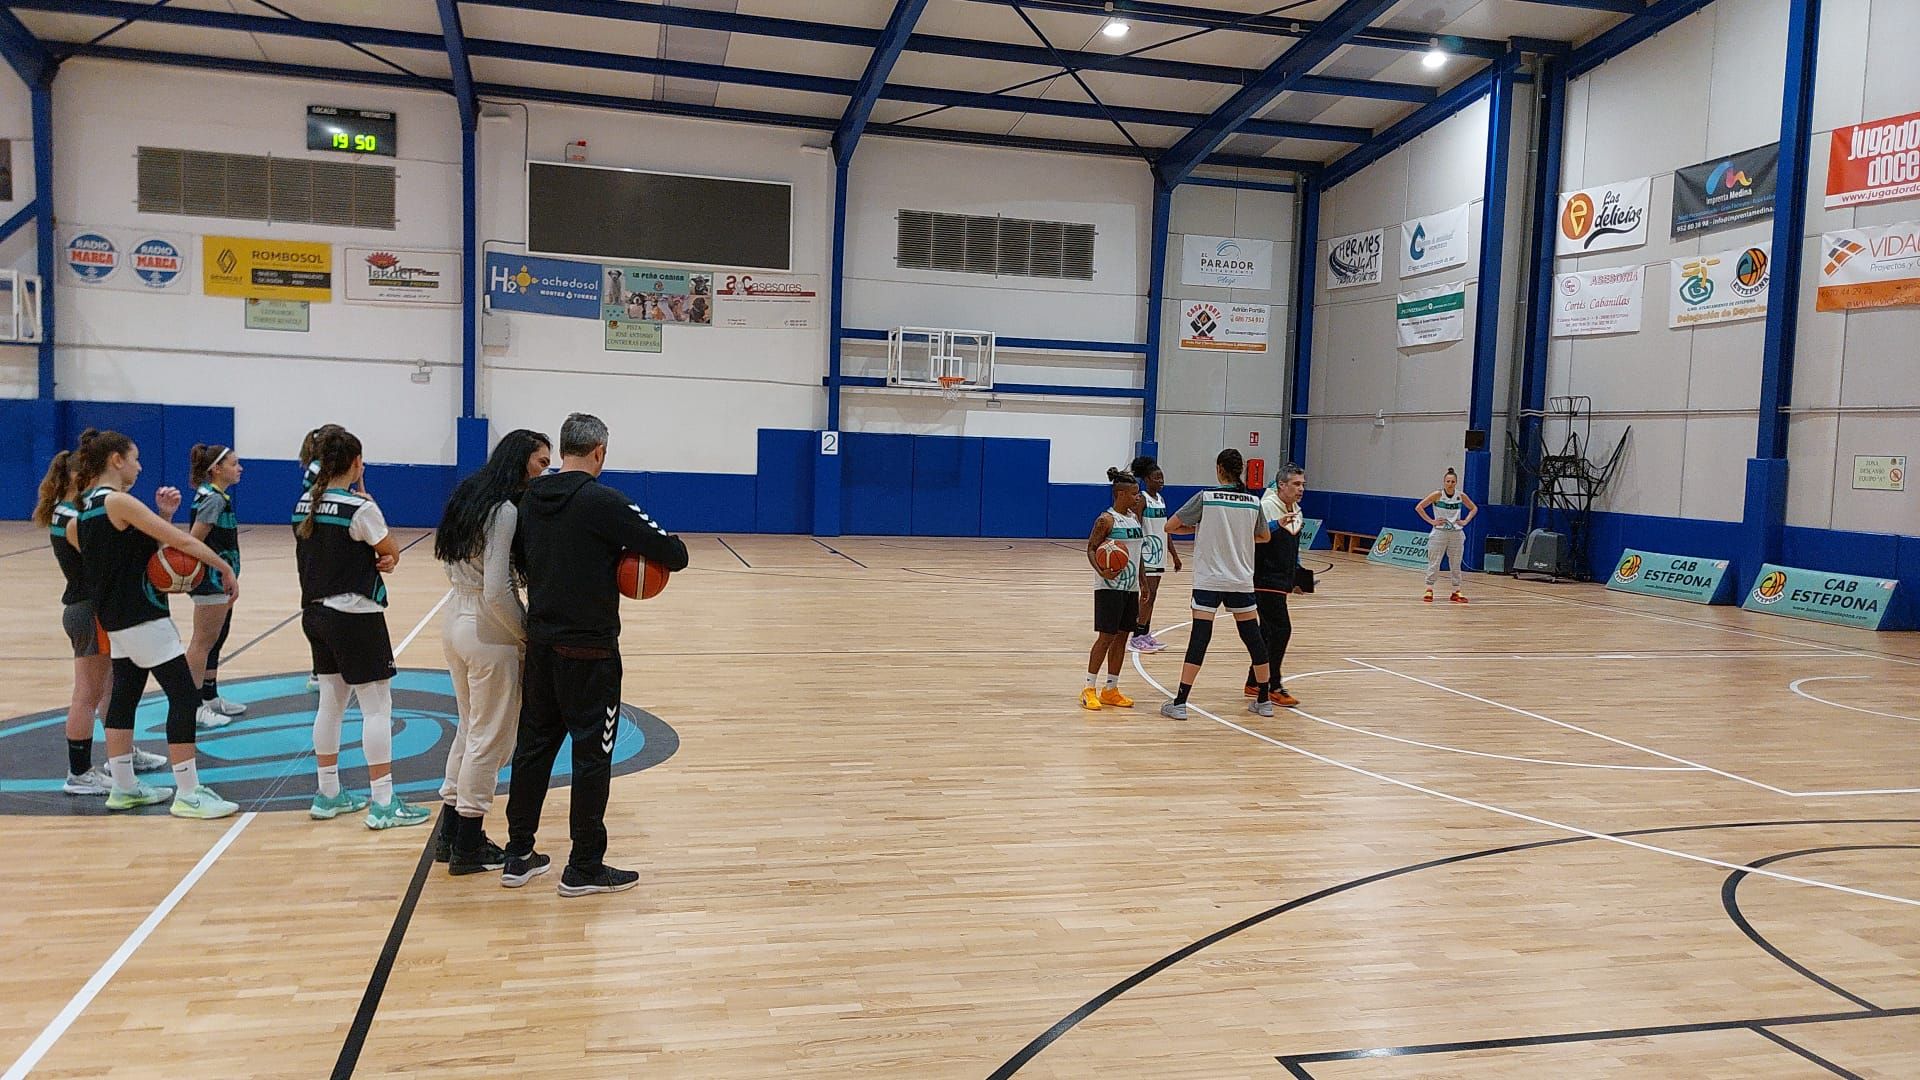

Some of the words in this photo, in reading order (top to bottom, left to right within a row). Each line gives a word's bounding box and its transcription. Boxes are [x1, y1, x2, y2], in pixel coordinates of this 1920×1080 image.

[333, 133, 348, 148] 19
[355, 135, 375, 150] 50
[1848, 119, 1920, 160] jugado
[1867, 150, 1920, 186] doce
[1603, 191, 1620, 206] Las
[1706, 194, 1728, 205] Imprenta
[1730, 188, 1752, 199] Medina
[1595, 206, 1642, 229] delicias
[76, 240, 109, 250] RADIO
[141, 245, 173, 256] RADIO
[72, 251, 113, 265] MARCA
[137, 256, 177, 269] MARCA
[252, 251, 324, 264] ROMBOSOL
[1201, 258, 1254, 270] PARADOR
[542, 277, 598, 290] achedosol
[752, 282, 802, 292] asesores
[1733, 276, 1769, 295] ESTEPONA
[1186, 304, 1202, 318] CASA
[824, 434, 836, 451] 2
[1213, 493, 1254, 503] ESTEPONA
[1154, 508, 1167, 517] CA
[1392, 545, 1429, 558] ESTEPON
[1671, 560, 1698, 572] CAB
[1644, 569, 1712, 588] ESTEPONA
[1824, 579, 1858, 593] CAB
[1790, 589, 1878, 612] ESTEPONA
